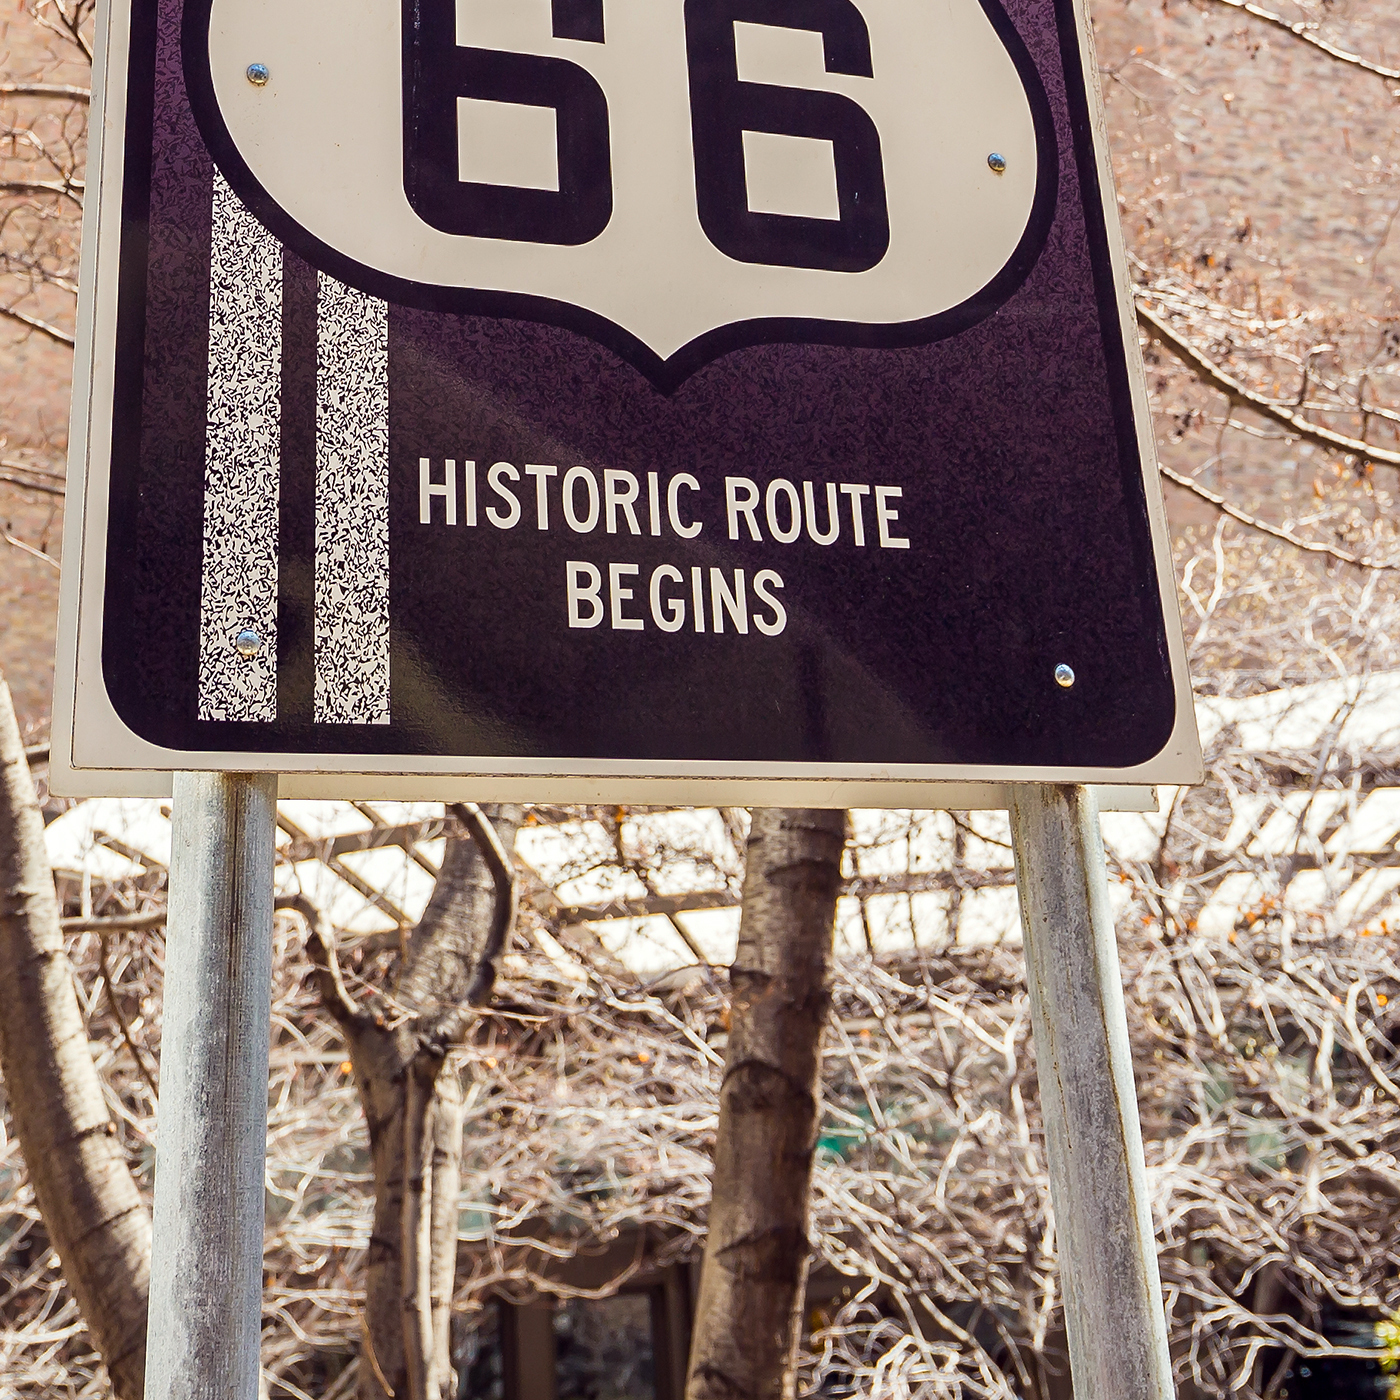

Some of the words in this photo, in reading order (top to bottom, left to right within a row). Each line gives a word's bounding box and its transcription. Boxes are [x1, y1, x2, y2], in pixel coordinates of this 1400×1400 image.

[418, 457, 702, 539] HISTORIC
[724, 476, 911, 549] ROUTE
[565, 560, 789, 637] BEGINS
